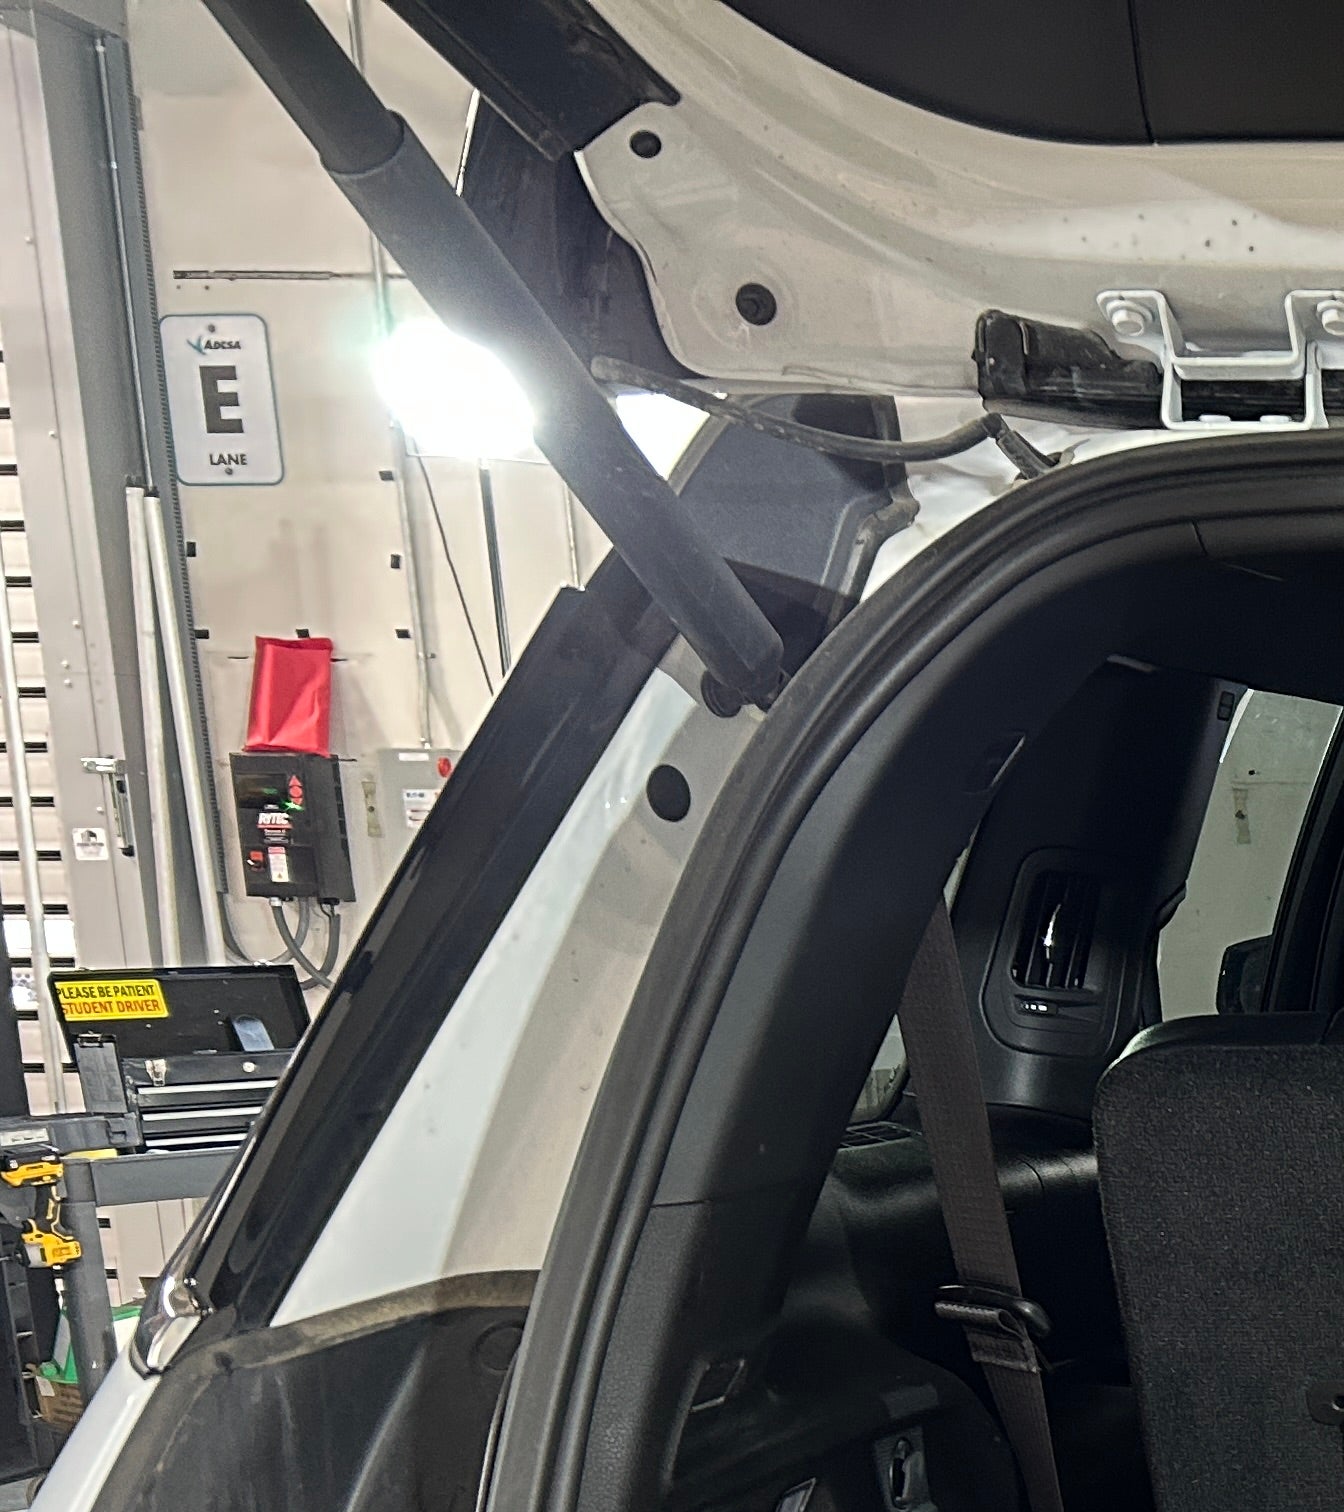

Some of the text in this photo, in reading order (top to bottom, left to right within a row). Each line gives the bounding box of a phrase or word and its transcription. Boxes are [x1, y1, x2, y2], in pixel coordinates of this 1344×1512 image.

[199, 365, 244, 434] E
[209, 453, 248, 466] LANE
[57, 985, 155, 999] PLEASE BE PATIENT
[61, 1000, 161, 1015] STUDENT DRIVER
